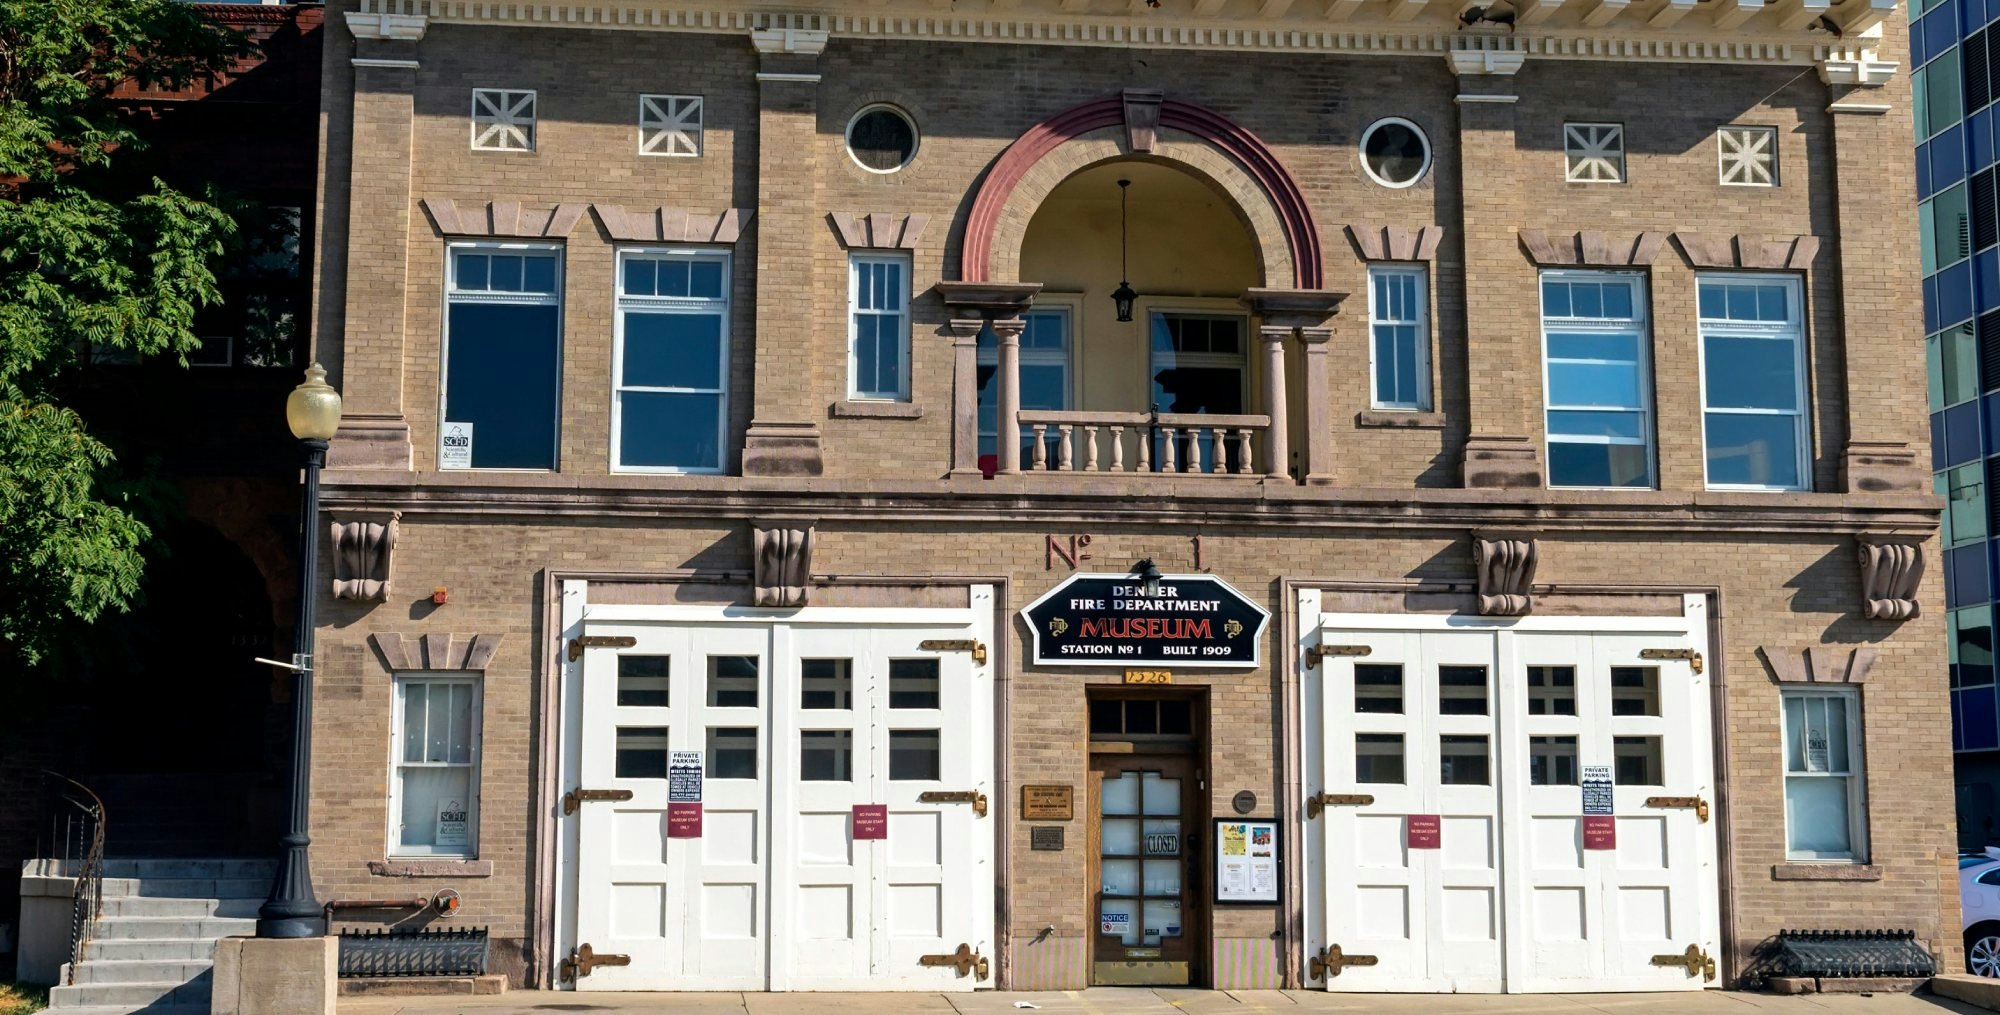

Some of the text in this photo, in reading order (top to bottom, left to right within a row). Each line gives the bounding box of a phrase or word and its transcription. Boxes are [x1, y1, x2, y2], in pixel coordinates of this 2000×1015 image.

[444, 437, 468, 446] SCFD
[1112, 585, 1179, 597] DENER
[1070, 598, 1220, 611] FIRE DEPARTMENT
[1079, 617, 1215, 638] MUSEUM
[1061, 644, 1113, 654] STATION
[1137, 645, 1142, 655] 1
[1163, 645, 1198, 655] BUILT
[1202, 646, 1232, 655] 1909
[1128, 671, 1167, 683] 1526
[441, 812, 465, 821] SCFD
[1147, 835, 1178, 853] CLOSED
[1102, 914, 1129, 922] NOTICE
